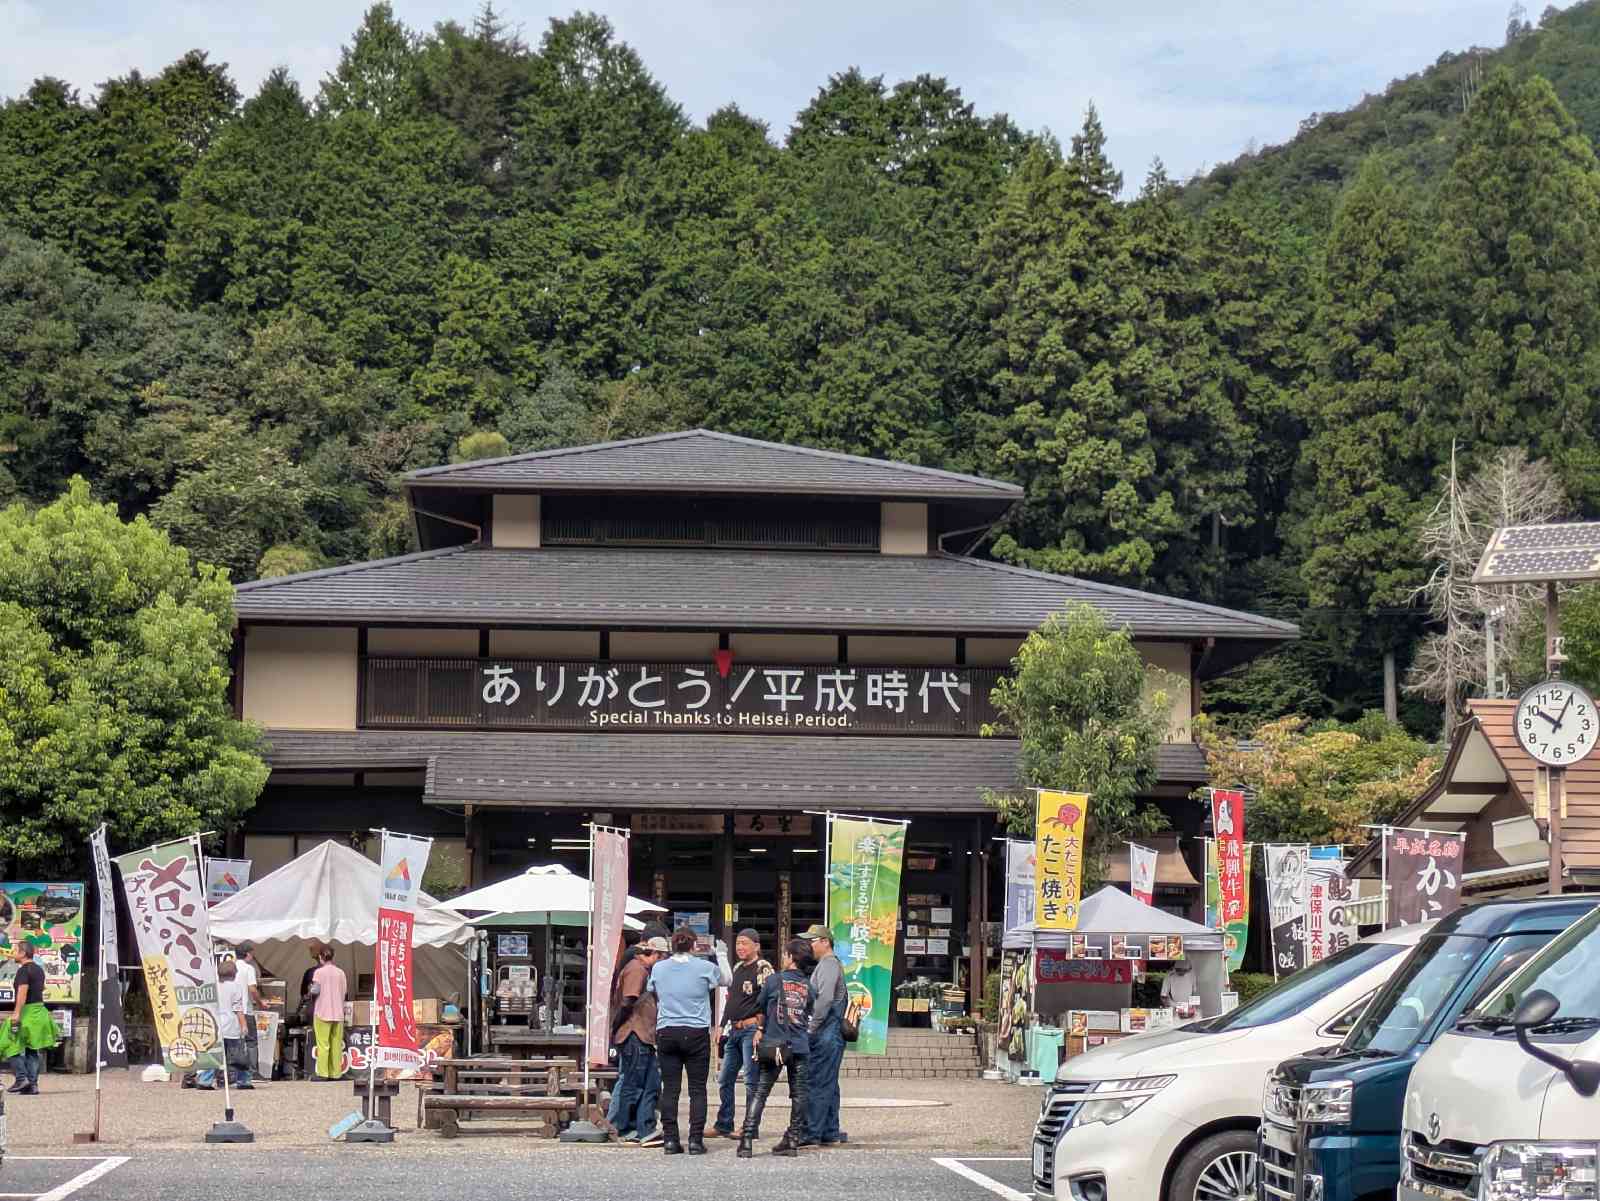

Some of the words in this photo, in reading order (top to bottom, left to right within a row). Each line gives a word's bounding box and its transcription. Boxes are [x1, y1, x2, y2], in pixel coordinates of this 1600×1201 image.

[1536, 694, 1546, 705] 11
[1550, 690, 1562, 701] 12
[1527, 705, 1539, 716] 10
[1577, 705, 1585, 716] 2
[590, 710, 648, 726] Special
[655, 711, 711, 725] Thanks
[717, 711, 732, 725] to
[739, 712, 788, 726] Heisei
[795, 713, 852, 727] Period.
[1523, 718, 1532, 730] 9
[1582, 719, 1590, 730] 3
[1529, 733, 1537, 744] 8
[1577, 733, 1584, 744] 4
[1540, 744, 1548, 754] 7
[1553, 747, 1561, 758] 6
[1568, 744, 1576, 754] 5
[1064, 837, 1079, 900] 大たこ入り
[1041, 834, 1062, 921] たこ焼き
[1311, 884, 1323, 959] 津保川天然
